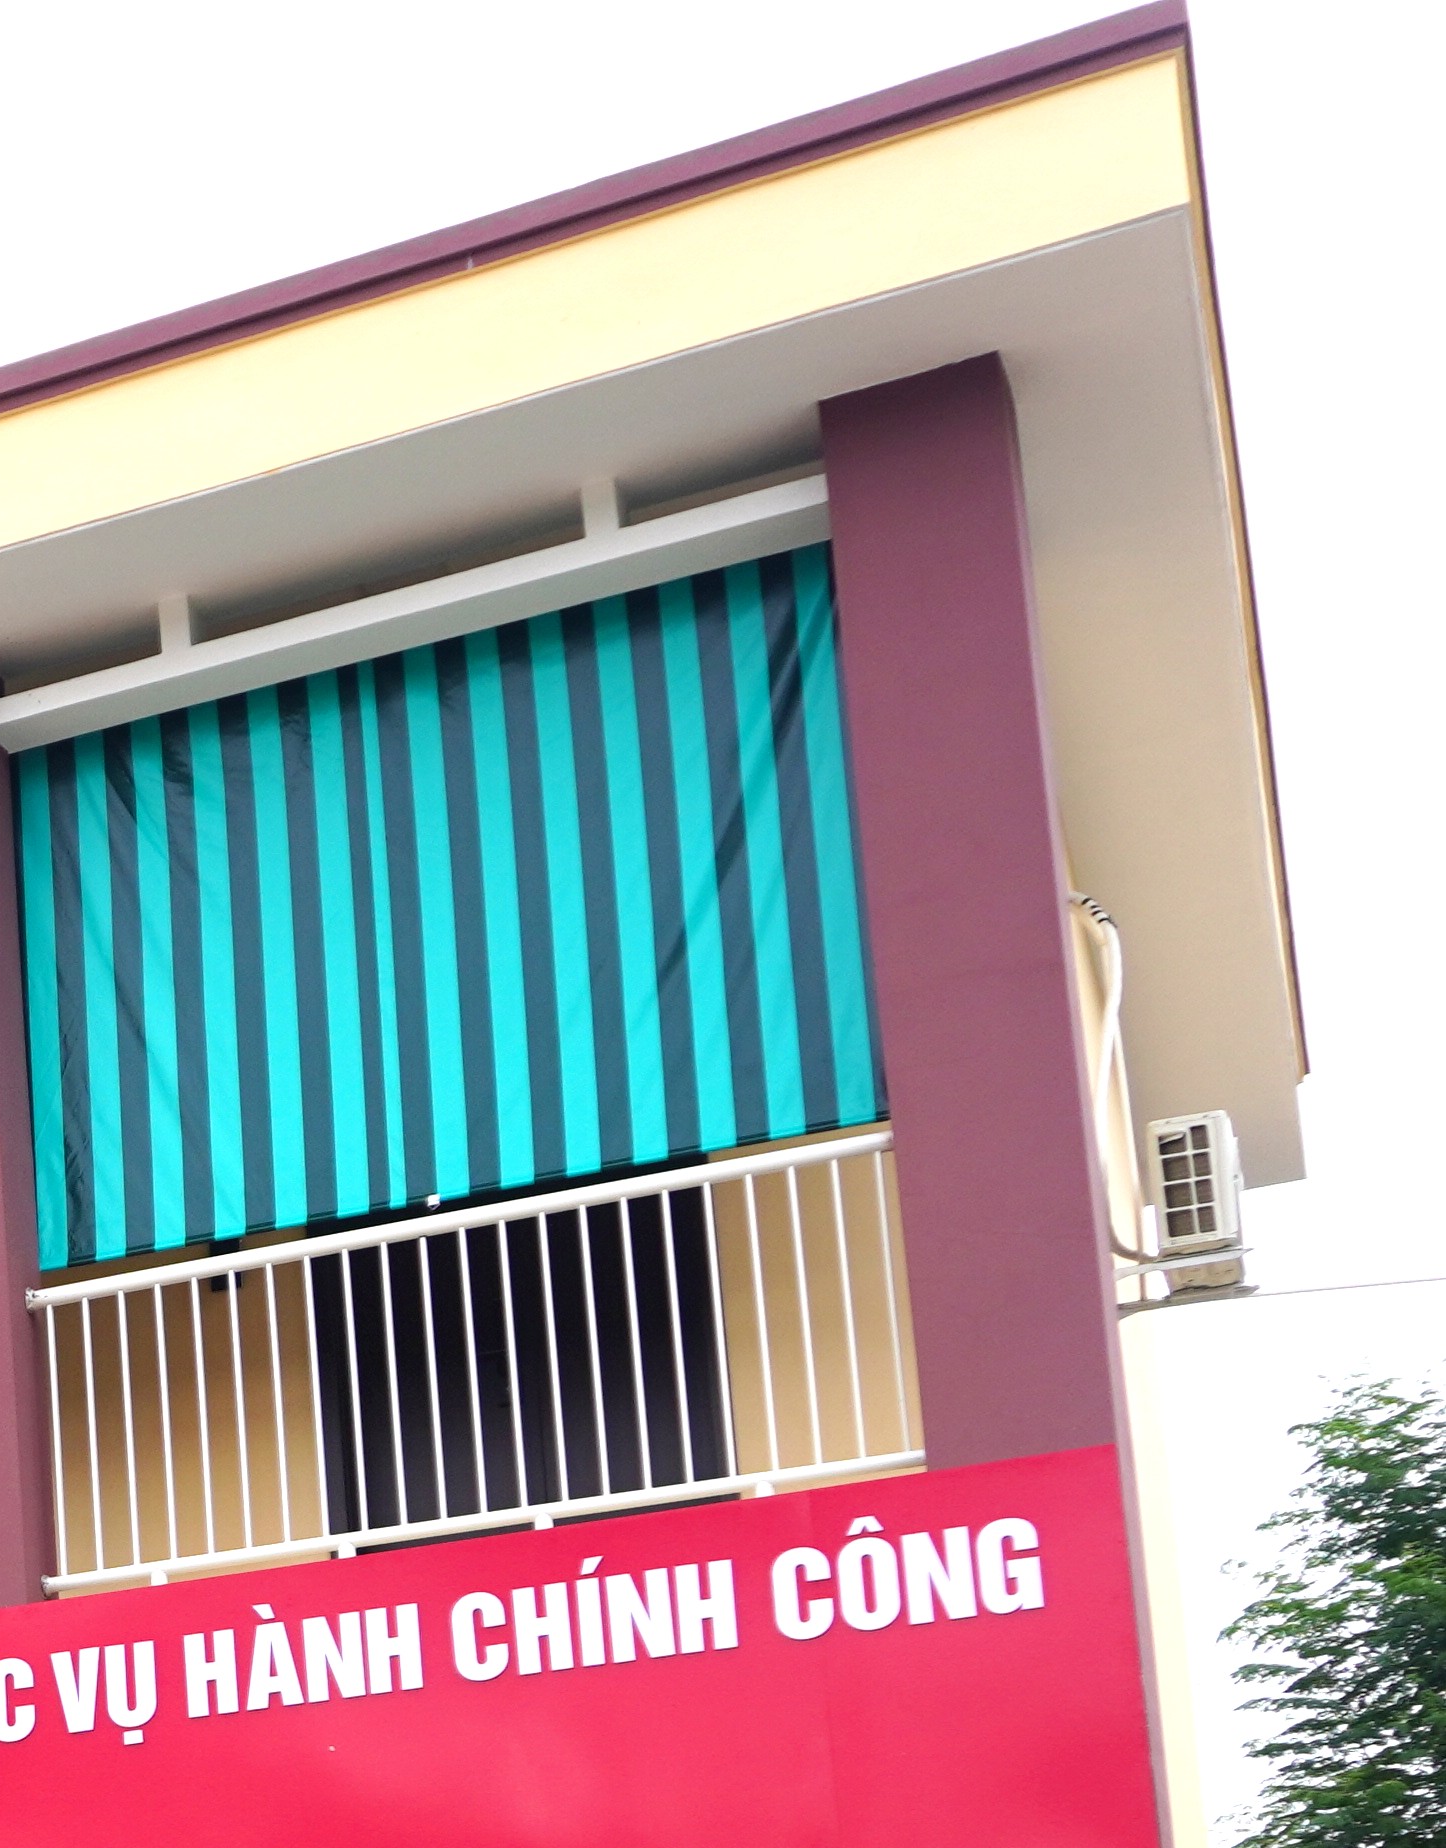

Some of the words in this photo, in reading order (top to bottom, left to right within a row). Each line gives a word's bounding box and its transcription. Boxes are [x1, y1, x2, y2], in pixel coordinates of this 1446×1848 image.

[51, 1641, 156, 1745] VỤ
[184, 1603, 423, 1718] HÀNH
[451, 1556, 738, 1681] CHÍNH
[772, 1516, 1044, 1639] CÔNG
